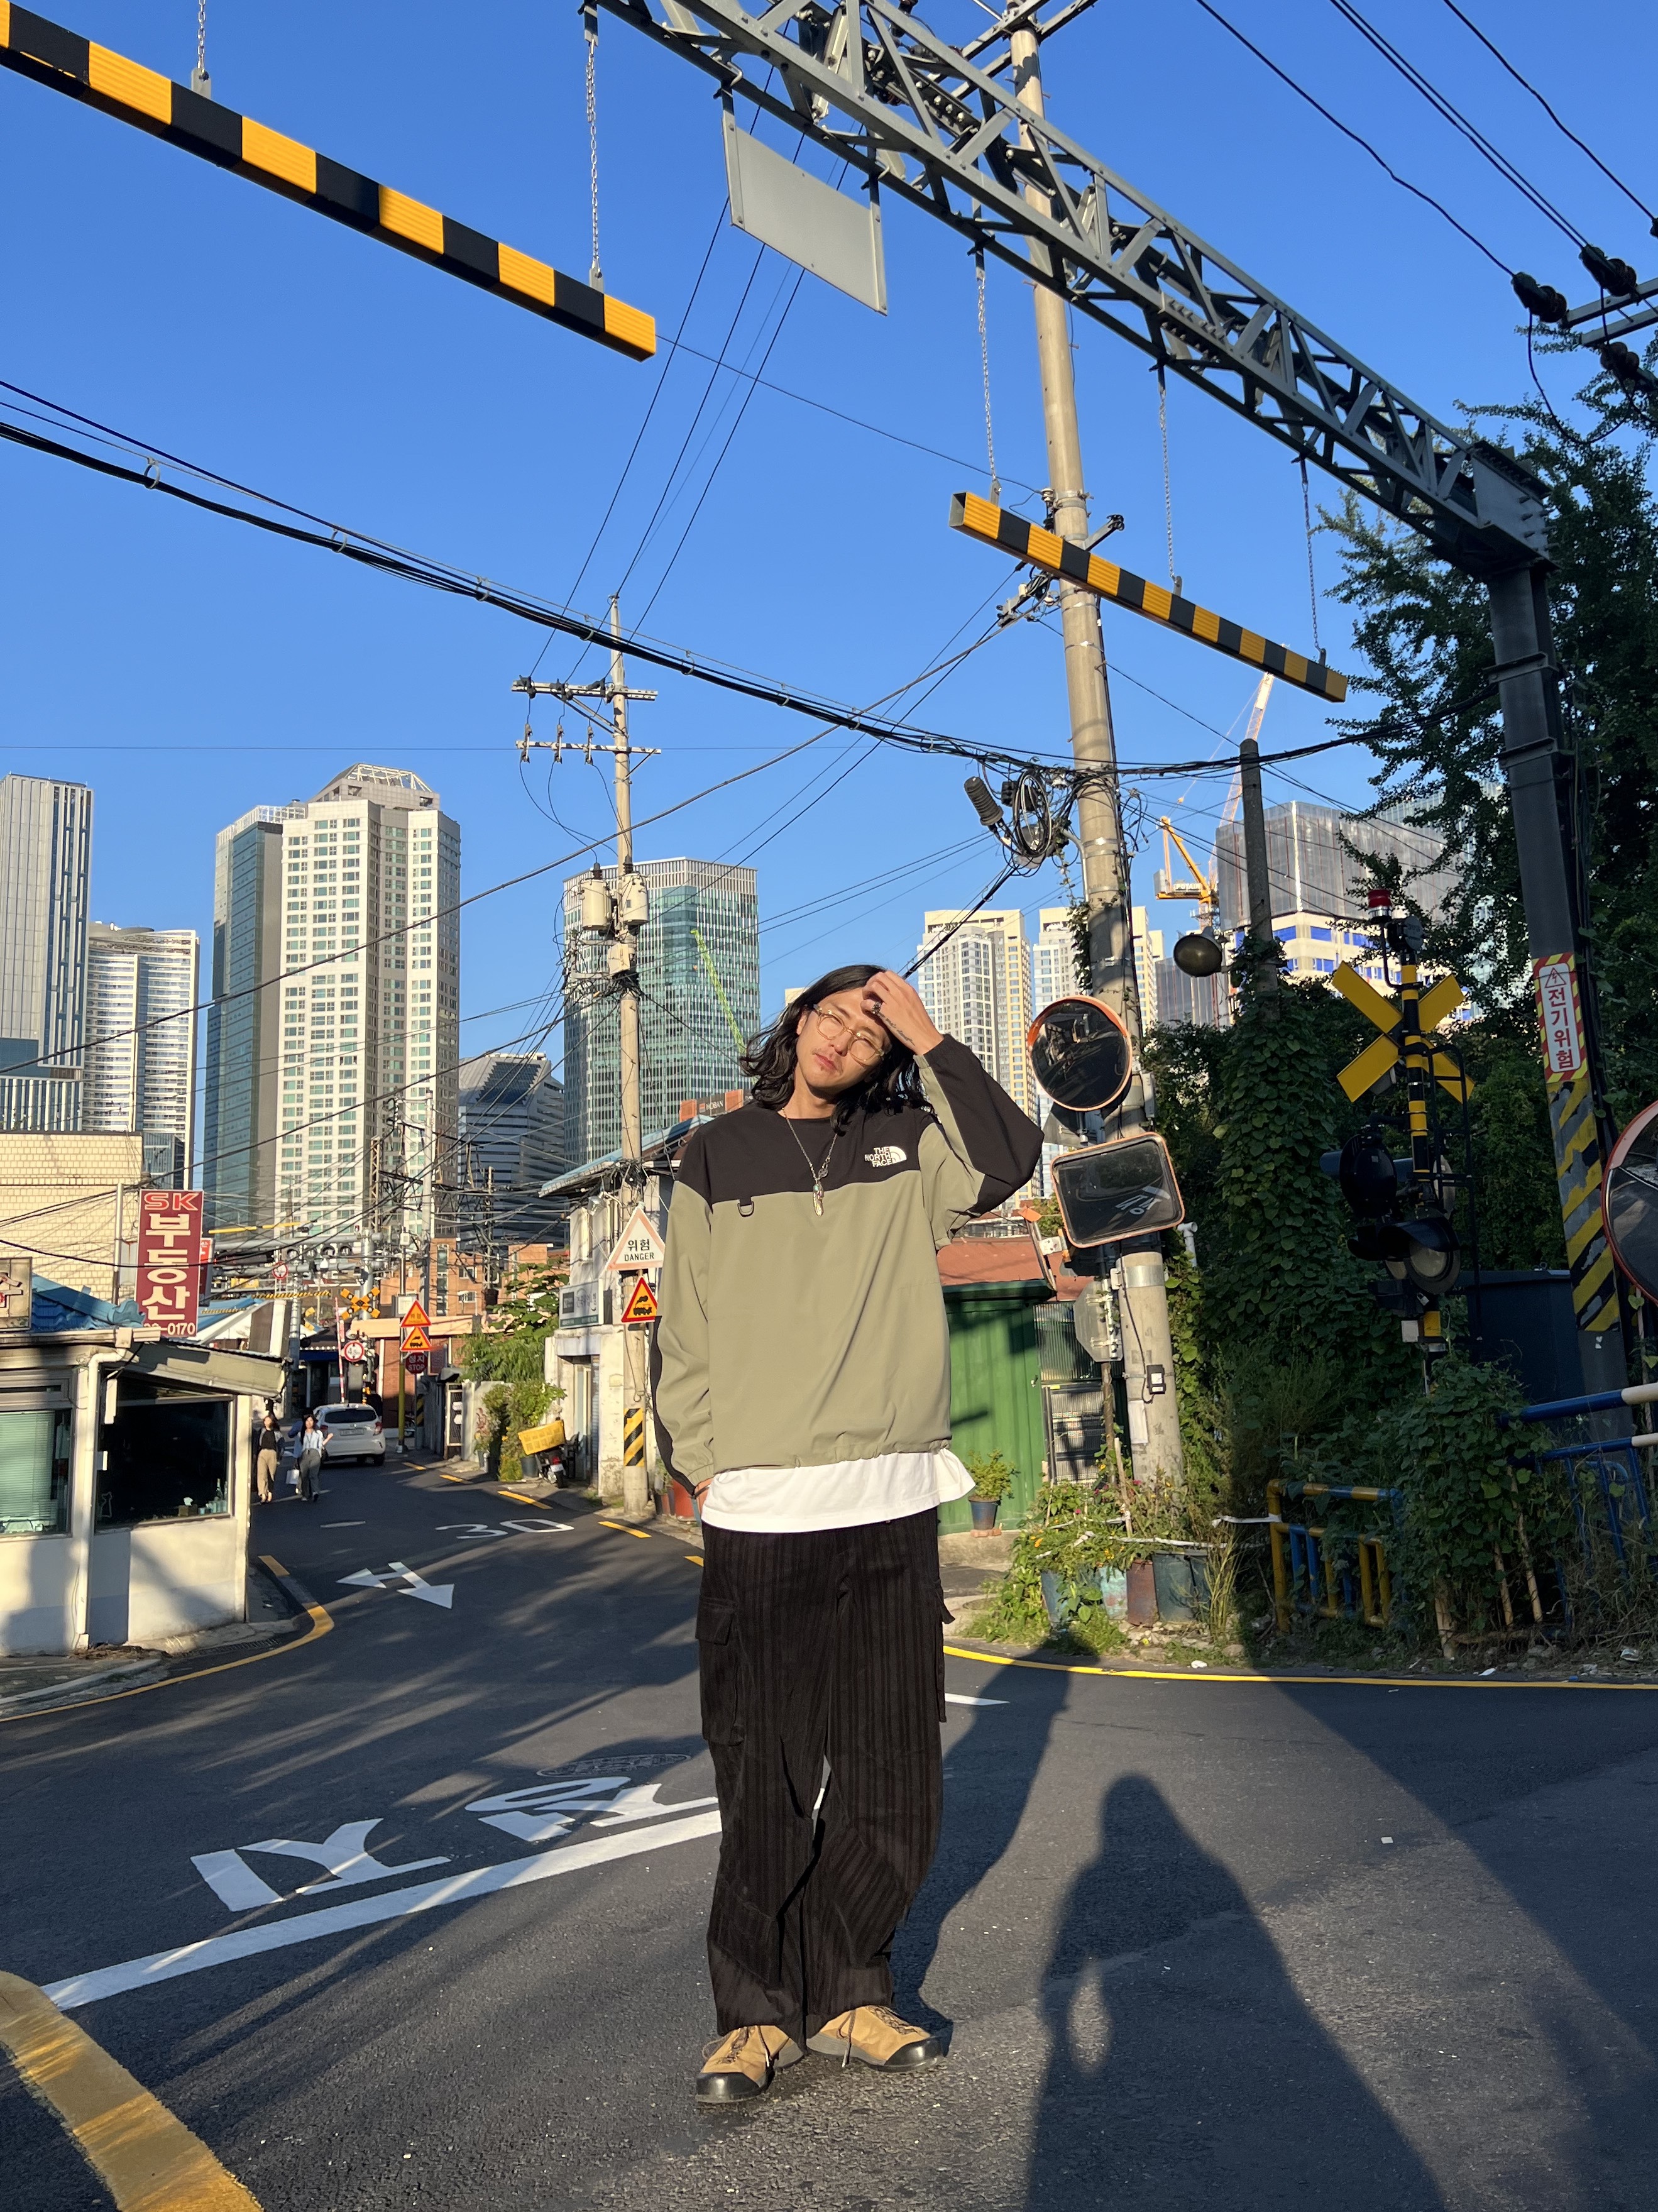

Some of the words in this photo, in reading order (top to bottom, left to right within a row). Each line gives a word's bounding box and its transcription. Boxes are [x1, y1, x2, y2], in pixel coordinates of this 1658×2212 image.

[1548, 987, 1574, 1069] 전기위험
[864, 1152, 891, 1162] NORTH
[873, 1146, 890, 1155] THE
[872, 1158, 892, 1167] FACE
[144, 1192, 199, 1211] SK
[627, 1238, 650, 1252] 위험
[623, 1252, 655, 1262] DANGER
[141, 1213, 191, 1321] 부동산
[435, 1518, 574, 1539] 30
